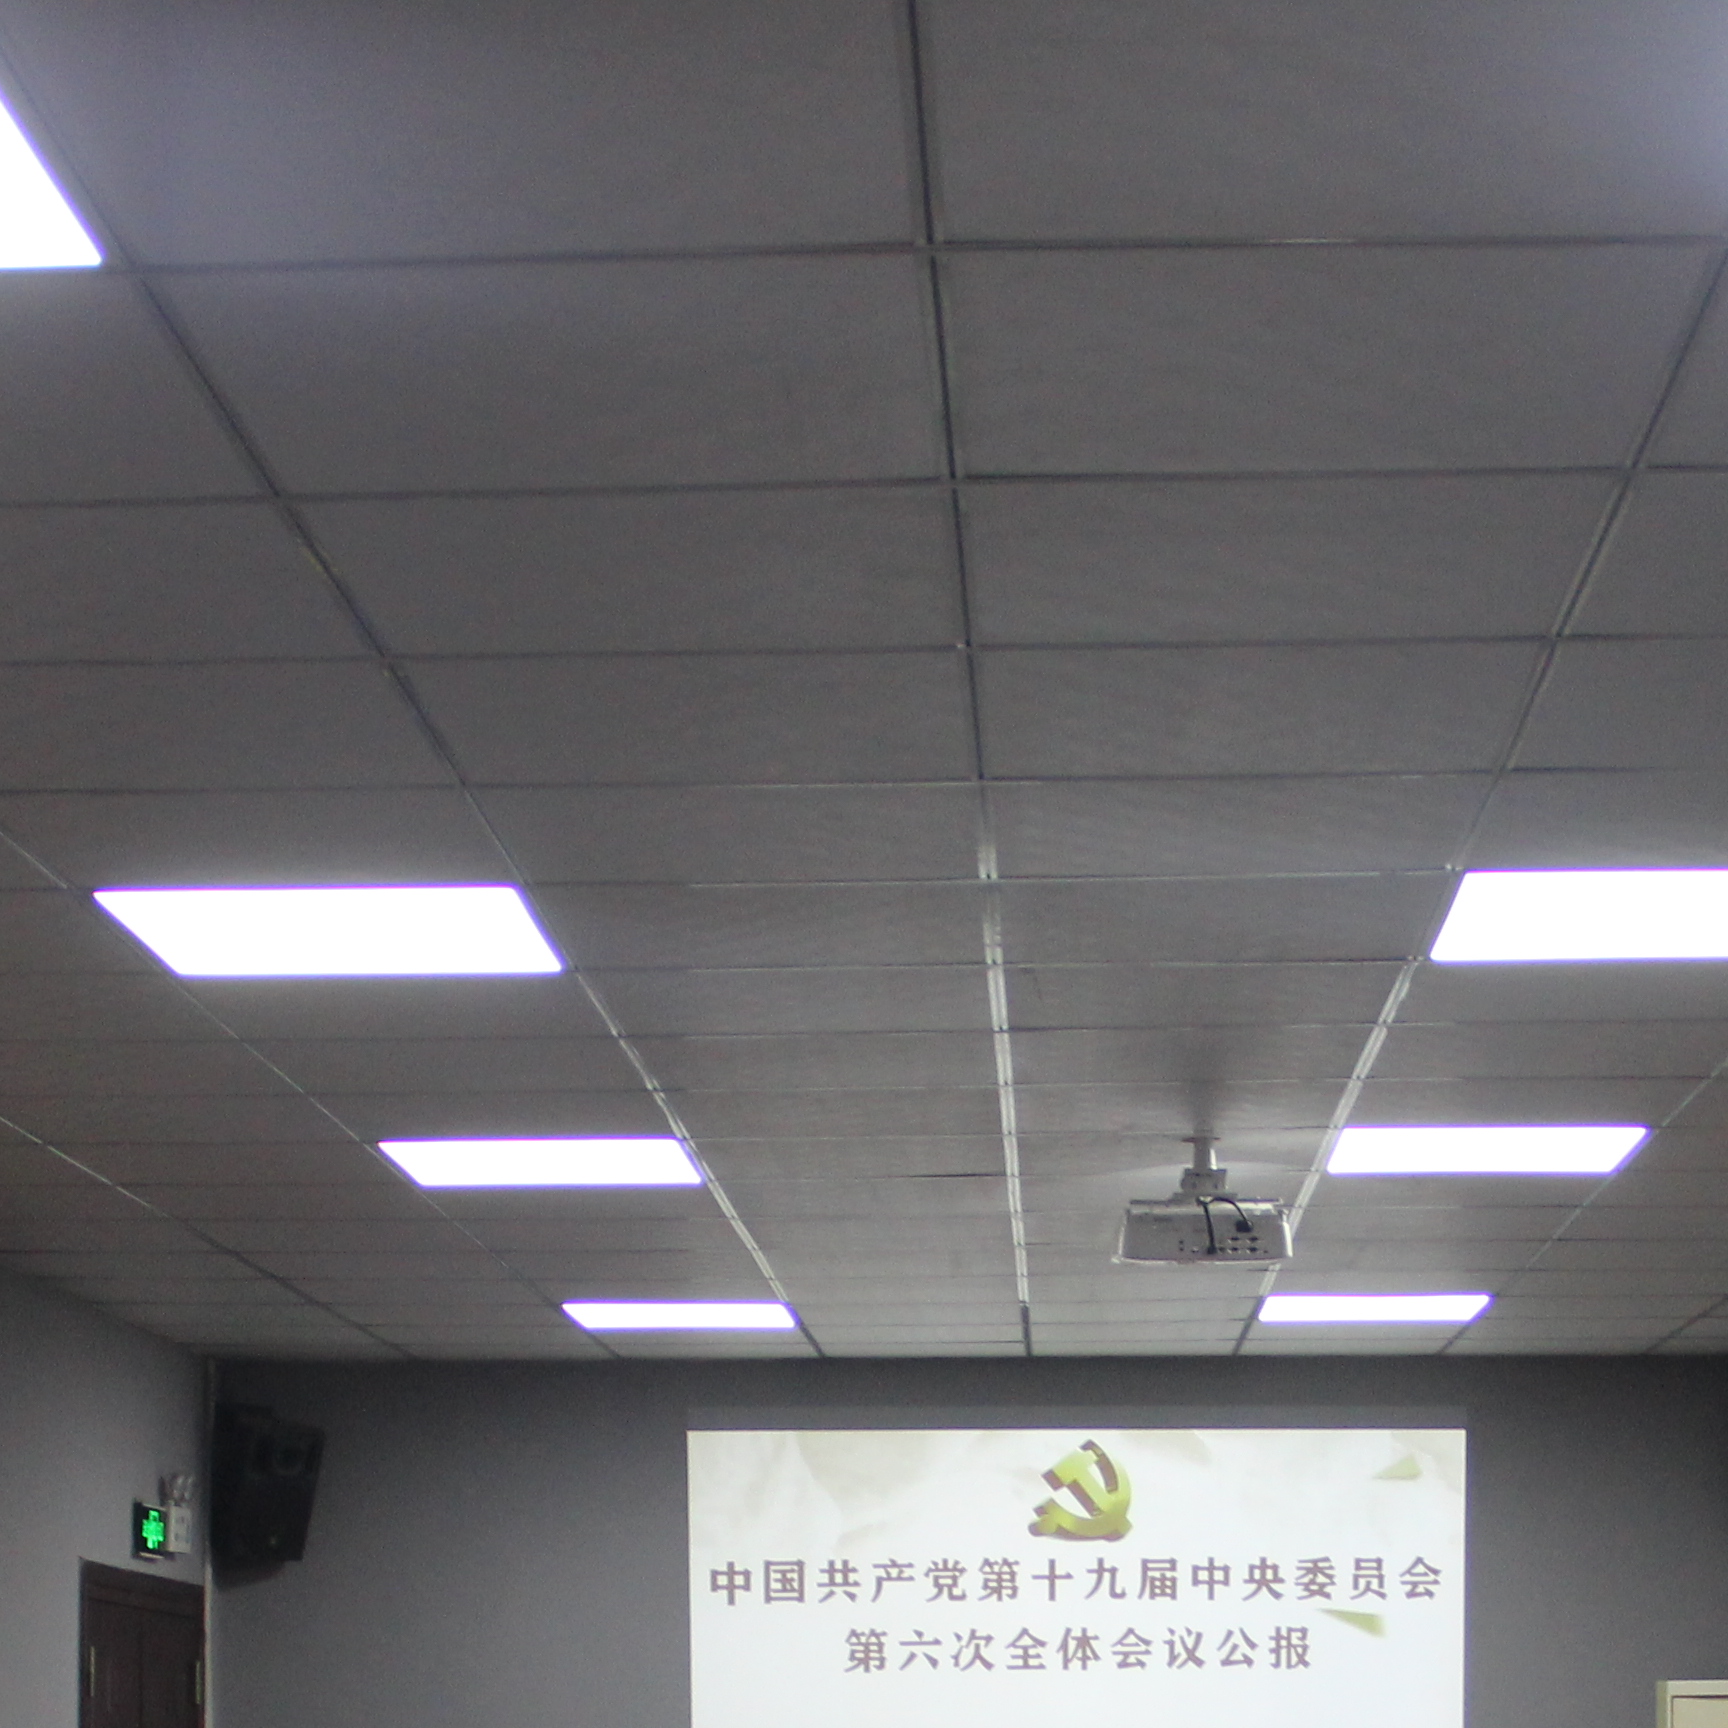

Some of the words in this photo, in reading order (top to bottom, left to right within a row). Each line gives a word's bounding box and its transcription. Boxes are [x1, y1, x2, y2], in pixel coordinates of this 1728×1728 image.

[708, 1556, 1443, 1605] 中国共产党第十九届中央委员会
[843, 1625, 1312, 1673] 第六次全体会议公报
